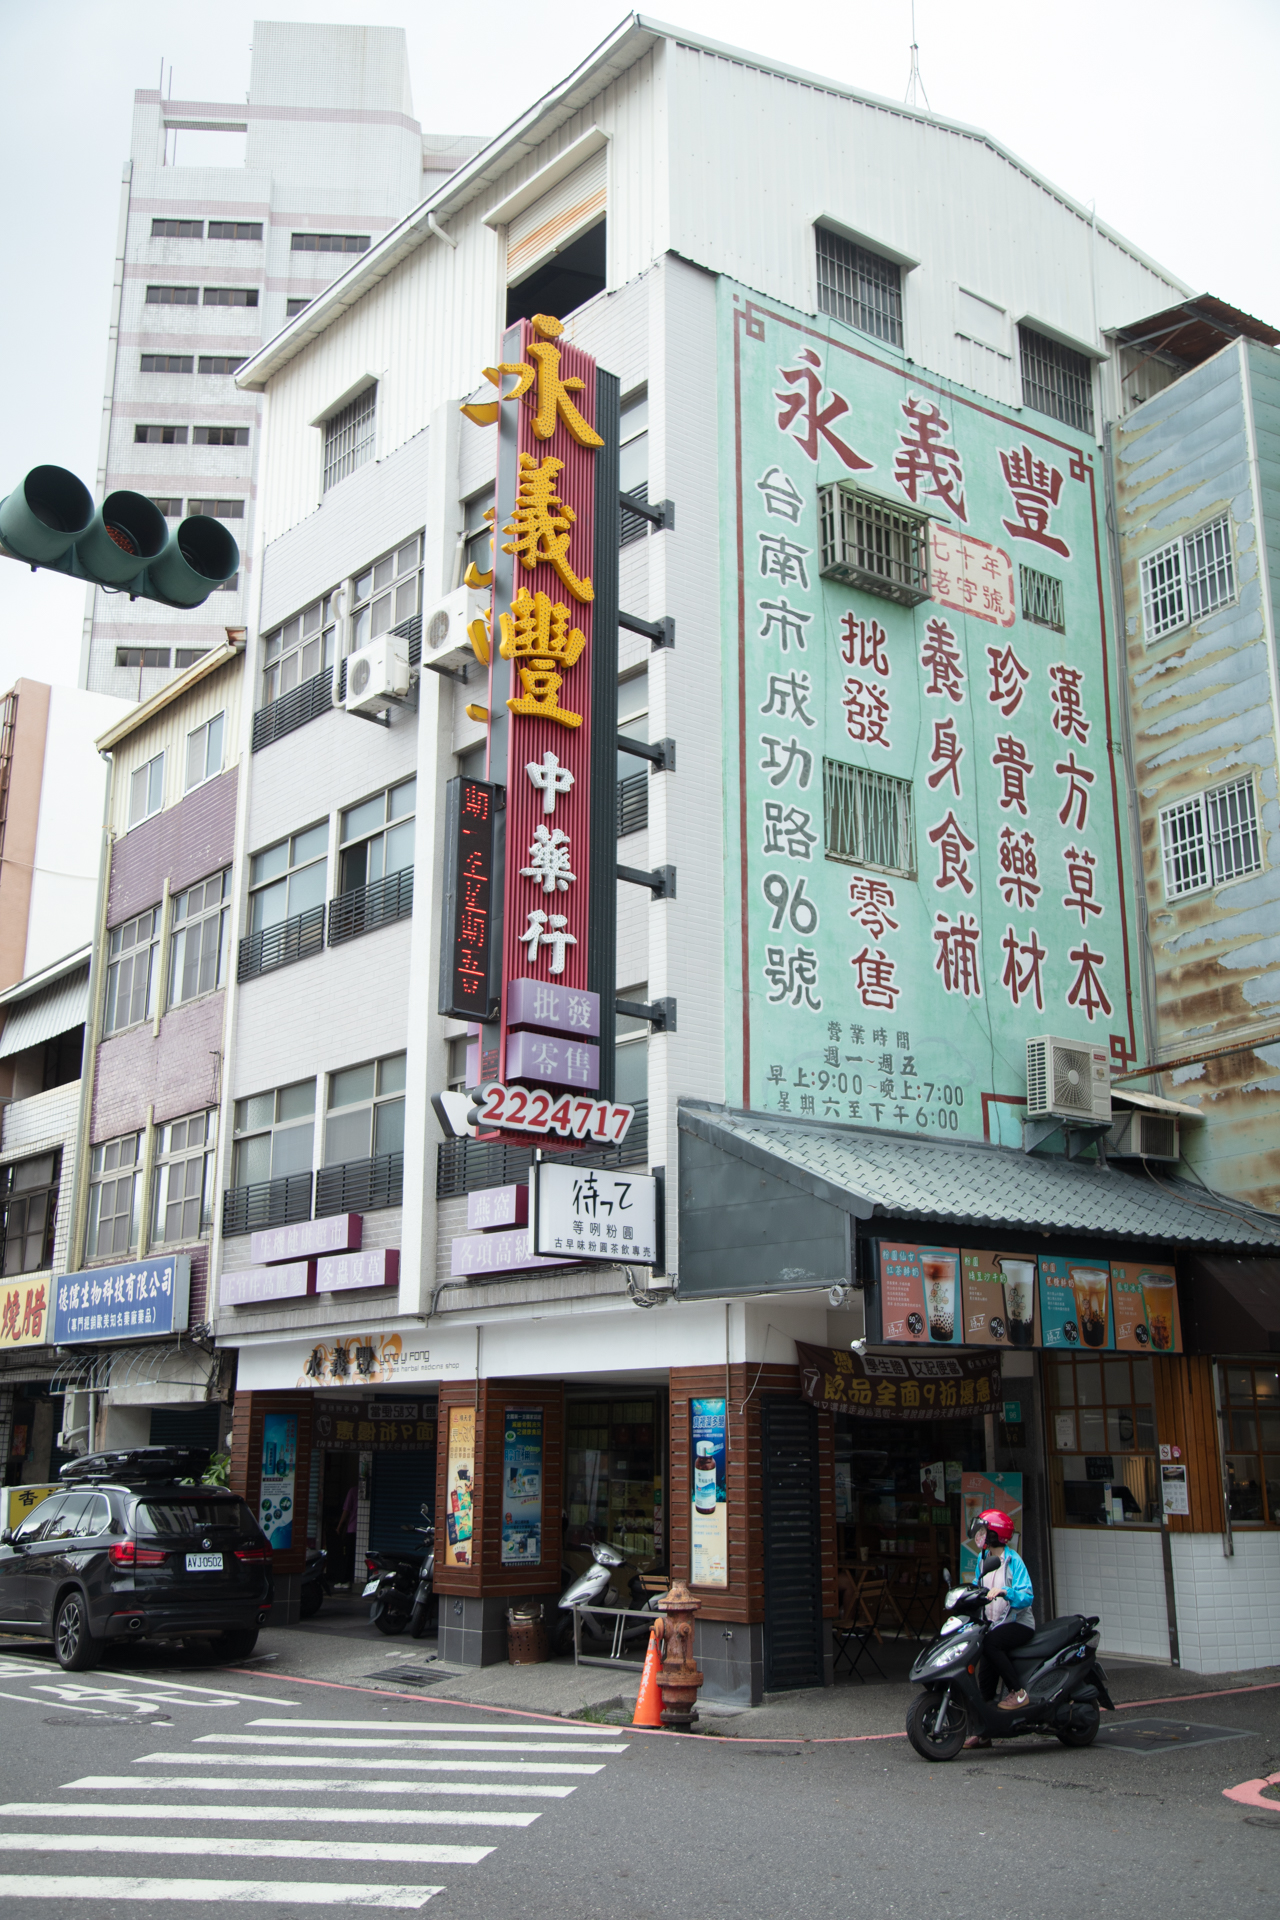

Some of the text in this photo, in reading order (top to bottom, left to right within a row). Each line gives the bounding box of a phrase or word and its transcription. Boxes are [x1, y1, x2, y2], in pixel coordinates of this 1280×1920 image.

[773, 345, 1071, 559] 永義豐
[930, 533, 1000, 580] 七十年
[930, 569, 1006, 616] 老字號
[496, 313, 606, 975] 永義豐 中藥行
[757, 467, 822, 1011] 台南市成功路96號
[840, 612, 900, 1010] 批發 零售
[921, 620, 981, 997] 養身食補
[988, 645, 1047, 1010] 珍貴藥材
[1049, 665, 1111, 1020] 漢方草本
[532, 987, 593, 1029] 批發
[827, 1020, 910, 1051] 營業時間
[531, 1041, 592, 1083] 零售
[482, 1087, 631, 1140] 2224717
[474, 1192, 510, 1224] 燕窩
[572, 1171, 633, 1219] 待って
[260, 1220, 343, 1258] 生機健康超市
[459, 1235, 545, 1270] 各項高級
[573, 1220, 633, 1240] 等咧粉圓
[58, 1267, 172, 1312] 德儒生物科技有限公司
[322, 1255, 381, 1286] 冬蟲夏草
[306, 1346, 374, 1377] 永義豐
[865, 1357, 961, 1377] 學生證 文記便當
[823, 1372, 991, 1407] 飲品全面9折優惠
